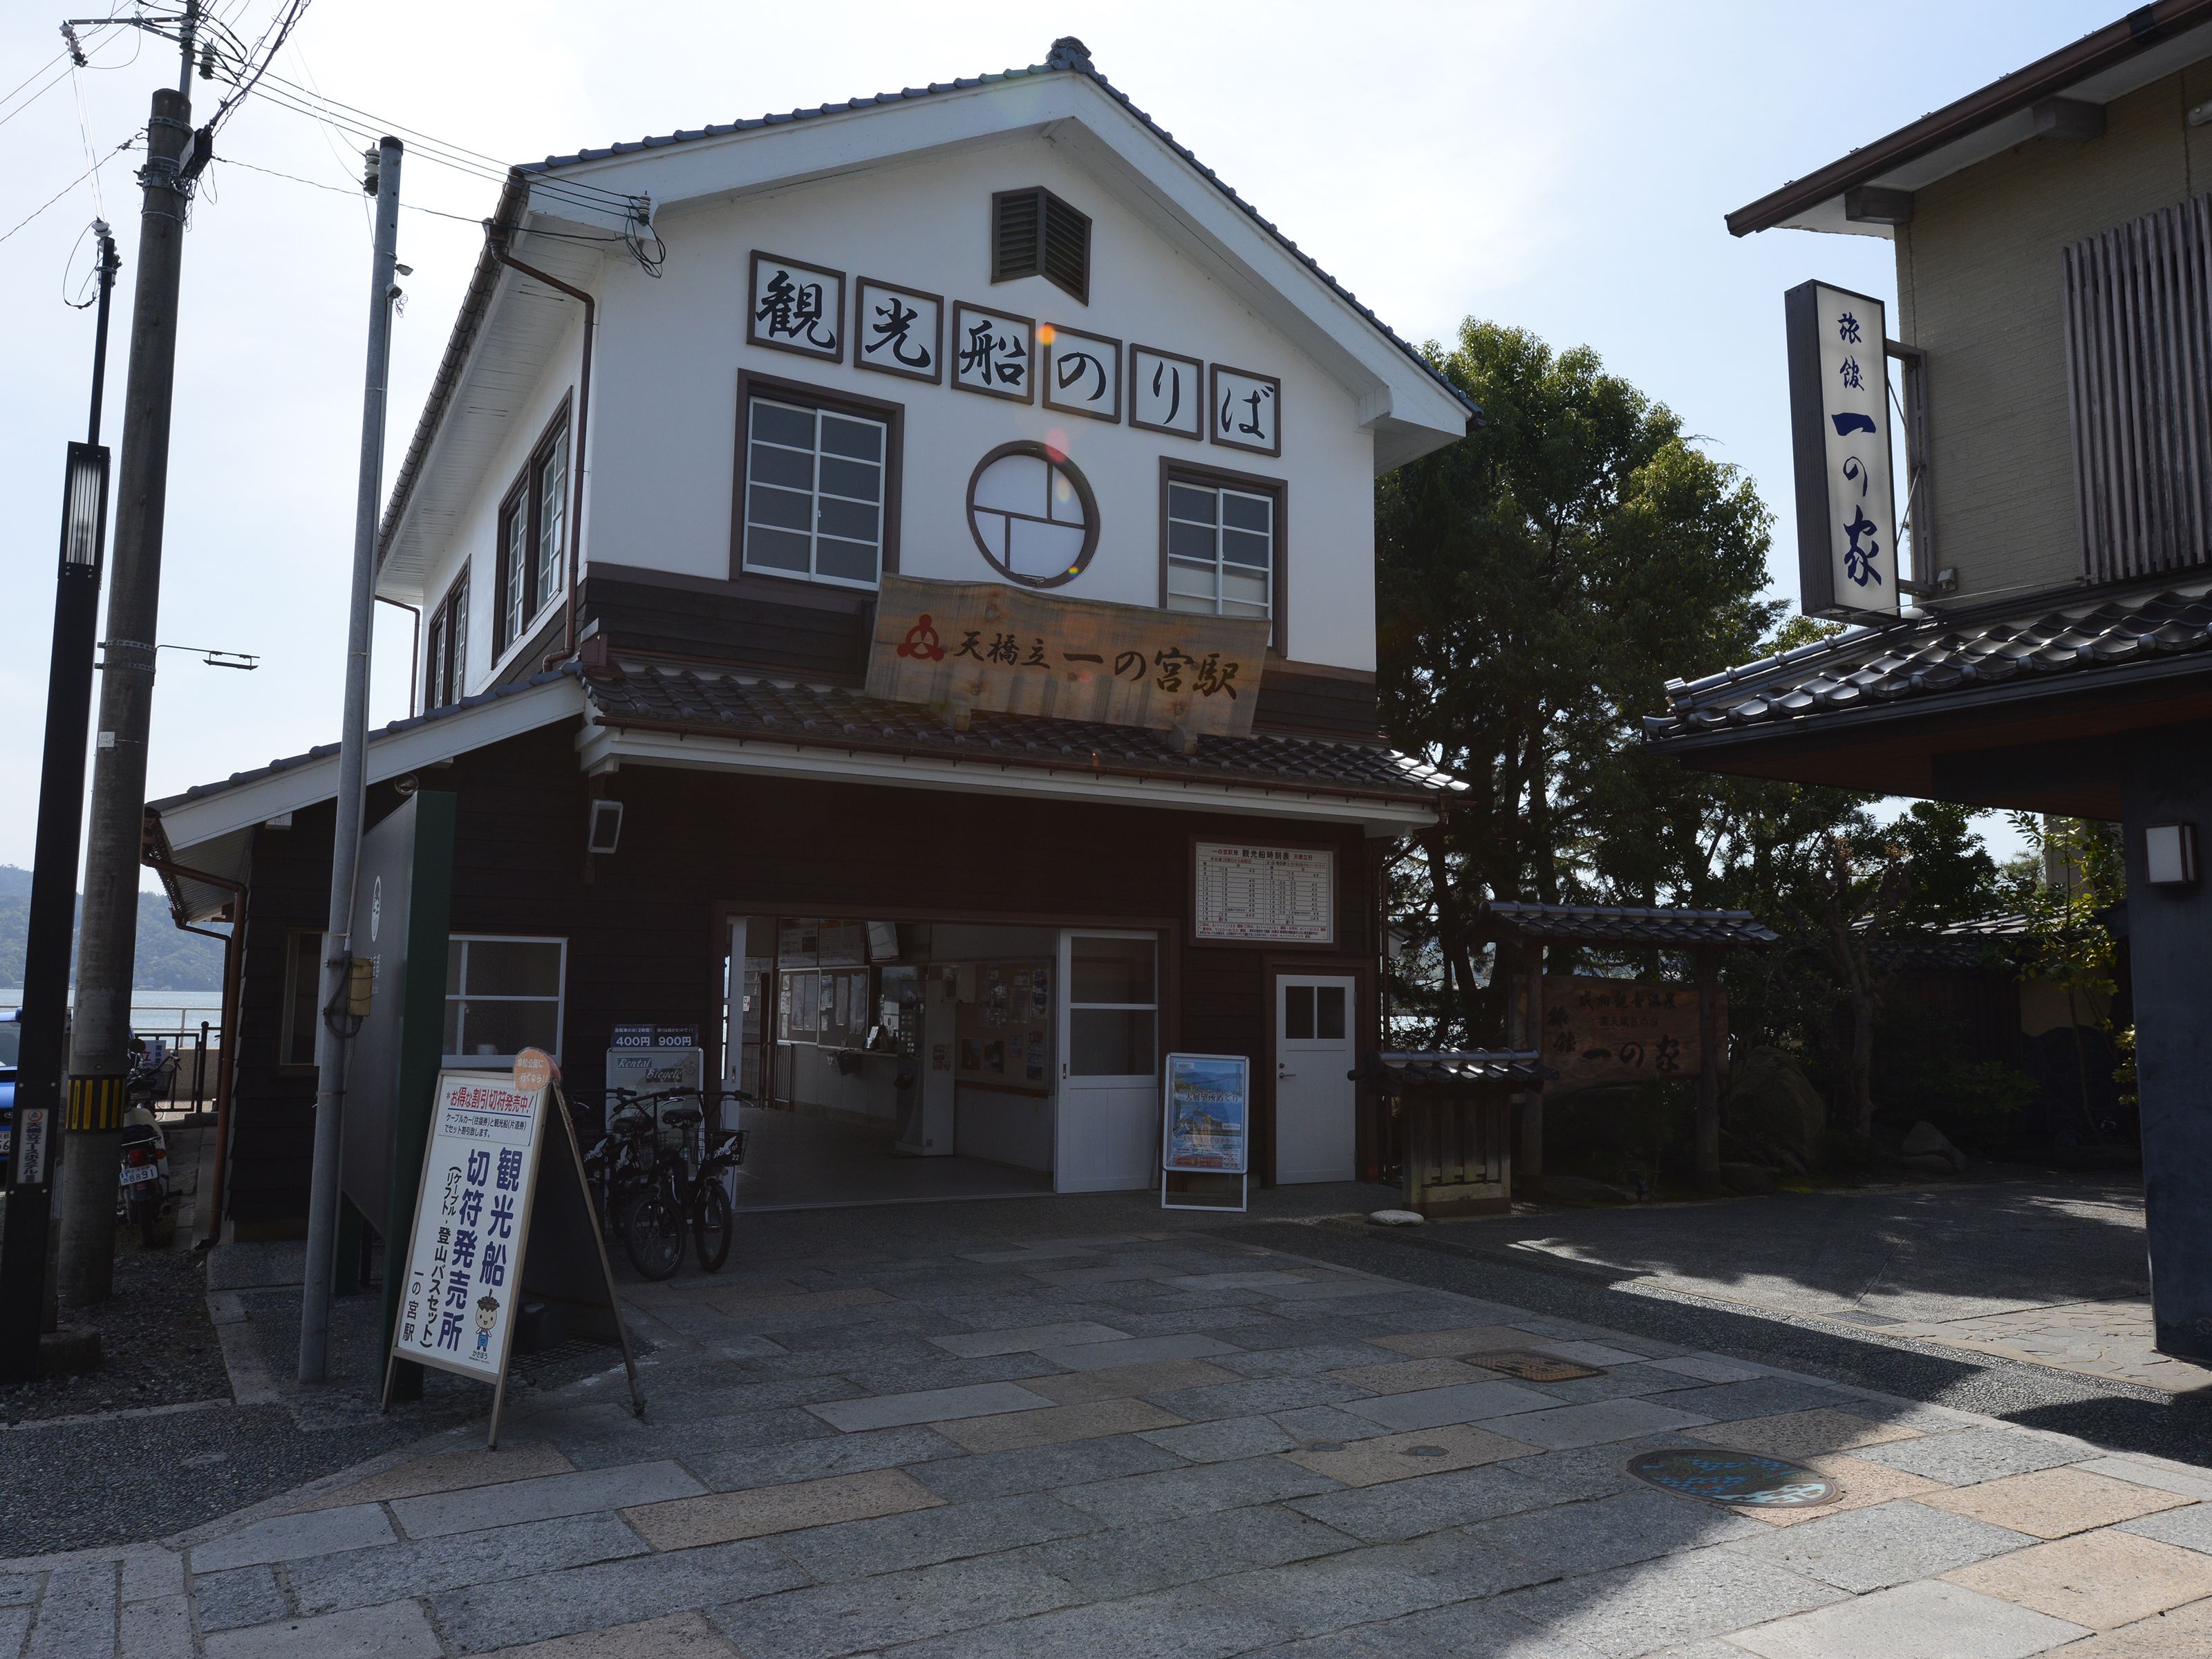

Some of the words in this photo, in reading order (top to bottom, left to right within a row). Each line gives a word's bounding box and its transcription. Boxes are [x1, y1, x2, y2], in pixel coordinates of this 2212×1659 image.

[756, 270, 1274, 440] 観光船のりば
[953, 630, 1239, 701] 天橋立一の宮駅
[1242, 849, 1290, 860] 観光船時刻表
[616, 1036, 650, 1047] 400円
[658, 1036, 691, 1047] 900円
[1582, 1034, 1680, 1073] 一の家
[618, 1058, 652, 1068] Rental
[646, 1069, 682, 1082] Bicycle
[1185, 1092, 1239, 1103] 大展望所めぐり
[23, 1122, 42, 1174] 天橋立ユースホステル
[129, 1169, 154, 1182] 8891
[479, 1147, 523, 1287] 観光船
[438, 1148, 491, 1351] 切符発売所
[402, 1271, 424, 1342] 一の宮駅
